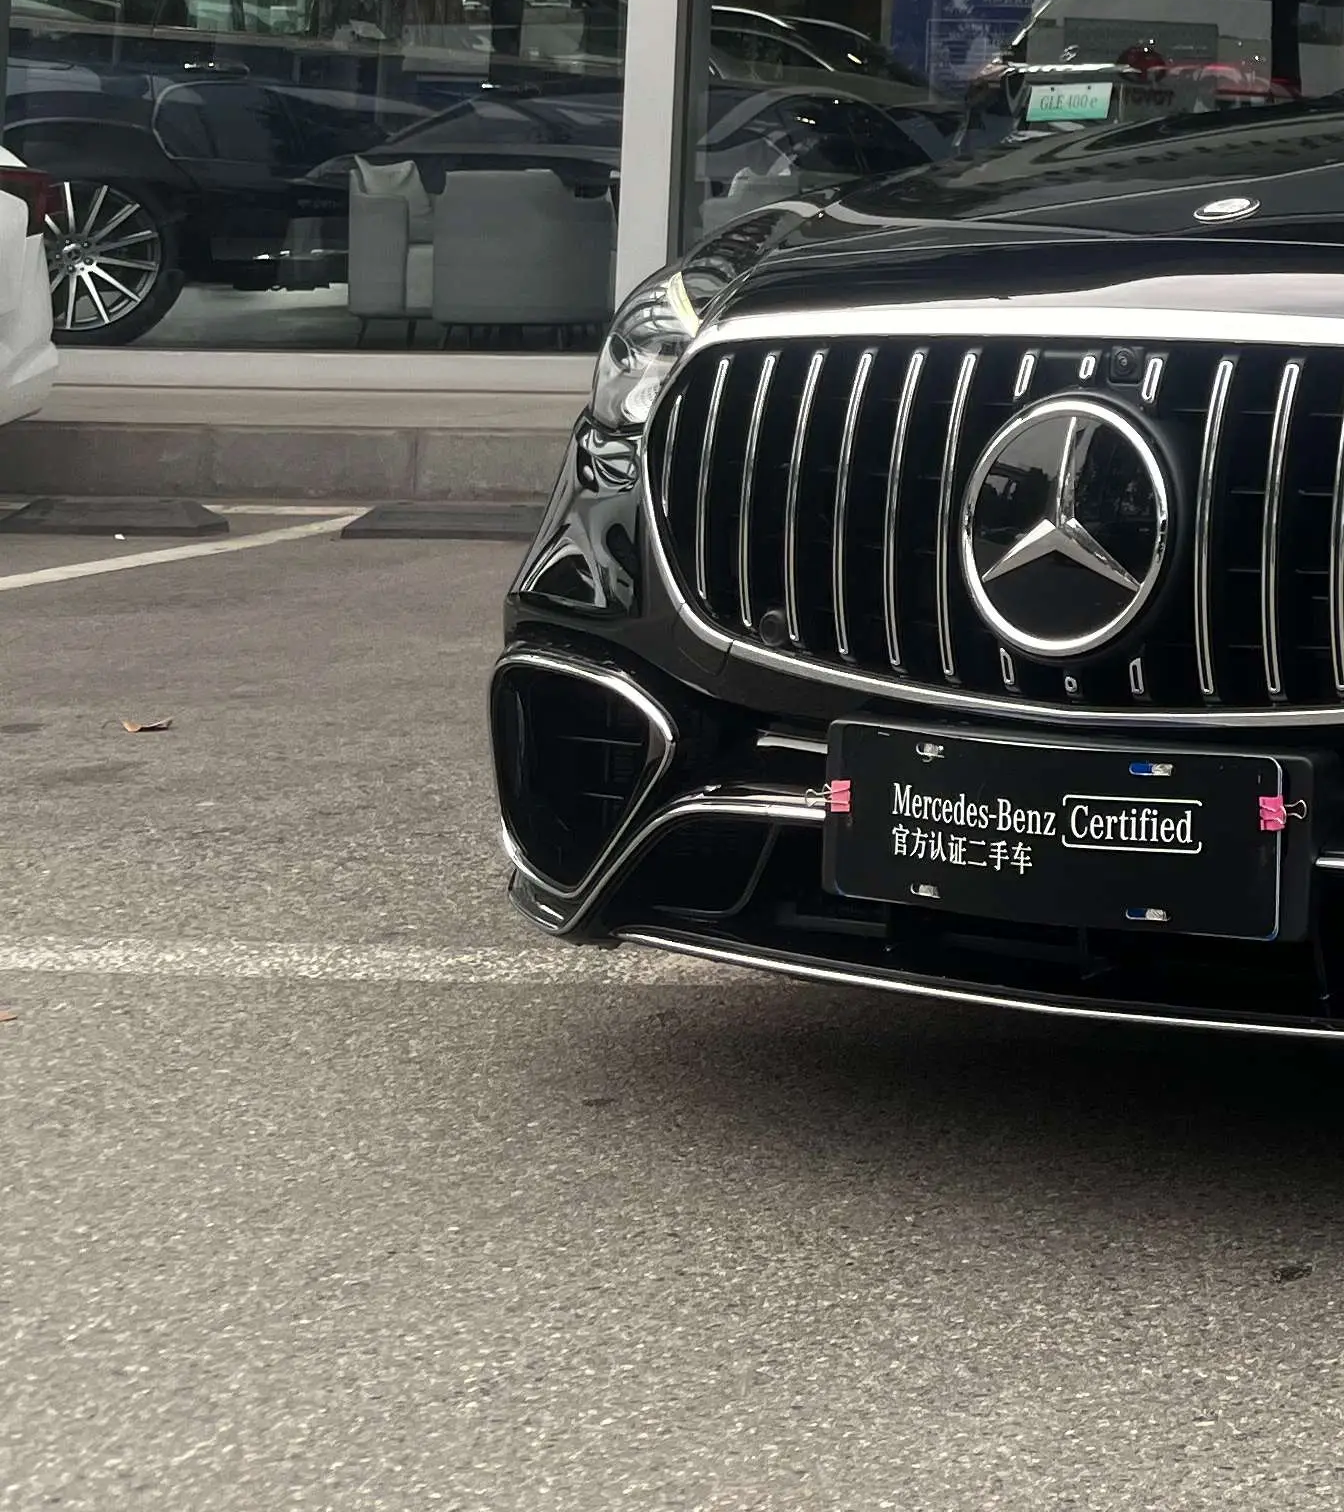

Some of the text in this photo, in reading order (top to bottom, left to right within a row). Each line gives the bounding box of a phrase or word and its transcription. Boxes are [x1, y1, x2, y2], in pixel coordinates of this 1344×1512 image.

[1040, 94, 1065, 112] GLE
[892, 783, 1193, 844] Mercedes-Benz Certified
[892, 823, 1033, 874] 官方认证二手车
